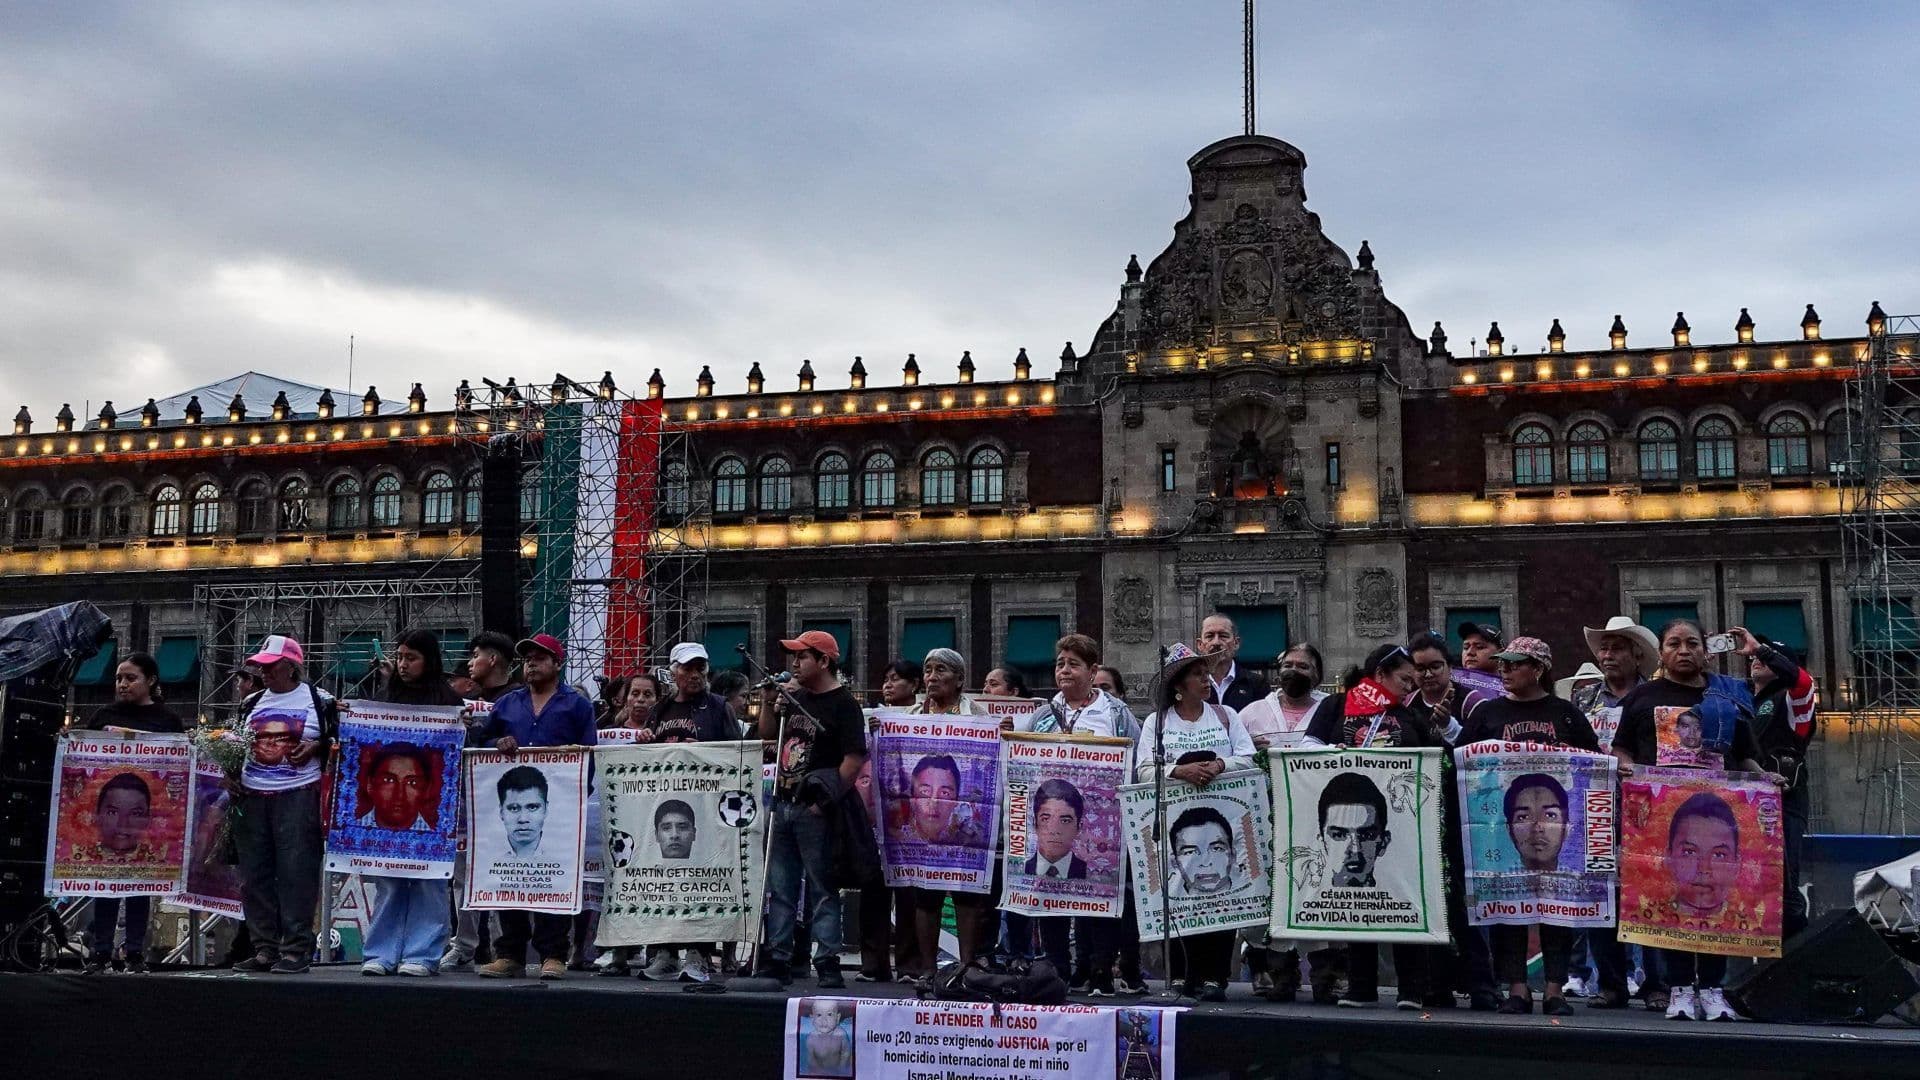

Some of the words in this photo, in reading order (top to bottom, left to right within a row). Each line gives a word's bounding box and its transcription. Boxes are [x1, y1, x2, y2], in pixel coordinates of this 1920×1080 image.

[346, 710, 379, 721] ¡Porque
[412, 714, 420, 723] lo
[619, 730, 633, 739] se
[880, 722, 909, 736] ¡Vivo
[913, 724, 928, 734] se
[931, 723, 943, 736] lo
[946, 724, 998, 740] llevaron!
[1502, 721, 1556, 740] AYOTZINAPA
[66, 741, 98, 754] ¡Vivo
[102, 744, 117, 754] se
[120, 743, 132, 754] lo
[135, 743, 188, 756] llevaron!
[1165, 742, 1199, 750] SCENCIO
[1466, 742, 1500, 758] ¡Vivo
[1504, 742, 1520, 752] se
[473, 753, 502, 764] ¡Vivo
[505, 753, 516, 764] se
[519, 753, 528, 764] lo
[1009, 744, 1036, 759] ¡Vivo
[1040, 748, 1053, 758] se
[1056, 746, 1066, 759] lo
[1070, 747, 1124, 763] llevaron!
[1290, 756, 1323, 773] ¡Vivo
[1326, 760, 1340, 770] se
[1342, 756, 1354, 770] lo
[1355, 756, 1412, 771] llevaron!
[646, 780, 657, 792] SE
[659, 780, 670, 792] LO
[672, 778, 720, 792] LLEVARON!
[1134, 791, 1156, 803] ¡Viv
[1167, 788, 1179, 798] se
[1182, 786, 1193, 796] lo
[1587, 791, 1612, 817] NOS
[1010, 834, 1026, 856] NOS
[350, 858, 372, 868] ¡Vivo
[374, 860, 383, 868] lo
[384, 862, 429, 872] queremos!
[489, 868, 524, 876] RUBÉN
[626, 866, 664, 878] MARTÍN
[666, 867, 735, 878] GETSEMANY
[500, 876, 552, 884] VILLEGAS
[926, 870, 978, 883] ueremos!
[60, 880, 91, 893] ¡Vivo
[94, 880, 106, 892] lo
[109, 881, 174, 894] queremos!
[531, 882, 552, 890] AÑOS
[622, 880, 674, 893] SÁNCHEZ
[679, 880, 731, 893] GARCÍA
[474, 889, 493, 904] ¡Con
[495, 890, 515, 902] VIDA
[518, 890, 526, 902] lo
[528, 892, 572, 904] queremos!
[641, 894, 666, 902] VIDA
[668, 894, 678, 902] lo
[683, 894, 738, 904] queremos!
[1008, 892, 1028, 906] ¡Vivo
[1028, 895, 1040, 907] lo
[1043, 898, 1110, 913] queremos!
[1321, 890, 1352, 901] CÉSAR
[1354, 890, 1393, 900] MANUEL
[1192, 900, 1230, 912] ASCENCIO
[1303, 900, 1353, 911] GONZÁLEZ
[1354, 900, 1412, 911] HERNÁNDEZ
[1484, 901, 1516, 917] ¡Vivo
[1520, 902, 1533, 914] lo
[1536, 903, 1600, 918] queremos!
[1178, 915, 1205, 929] VIDA
[1206, 914, 1216, 925] lo
[1296, 910, 1320, 924] ¡Con
[1320, 910, 1348, 923] VIDA
[1348, 911, 1360, 923] lo
[1362, 912, 1419, 926] queremos!
[1620, 924, 1662, 937] CHRISTIAN
[1665, 930, 1698, 942] ALFONSO
[916, 1012, 930, 1025] DE
[932, 1012, 984, 1028] ATENDER
[1006, 1016, 1038, 1030] CASO
[866, 1030, 892, 1044] llevo
[894, 1031, 912, 1047] ¡20
[914, 1032, 940, 1046] años
[942, 1034, 994, 1050] exigiendo
[996, 1036, 1050, 1051] JUSTICIA
[1056, 1041, 1074, 1055] por
[1076, 1040, 1088, 1052] el
[884, 1050, 936, 1064] homicidio
[938, 1052, 1010, 1068] internacional
[1012, 1055, 1026, 1069] de
[1030, 1056, 1042, 1070] mi
[1046, 1057, 1070, 1072] niño
[908, 1069, 943, 1080] Ismael
